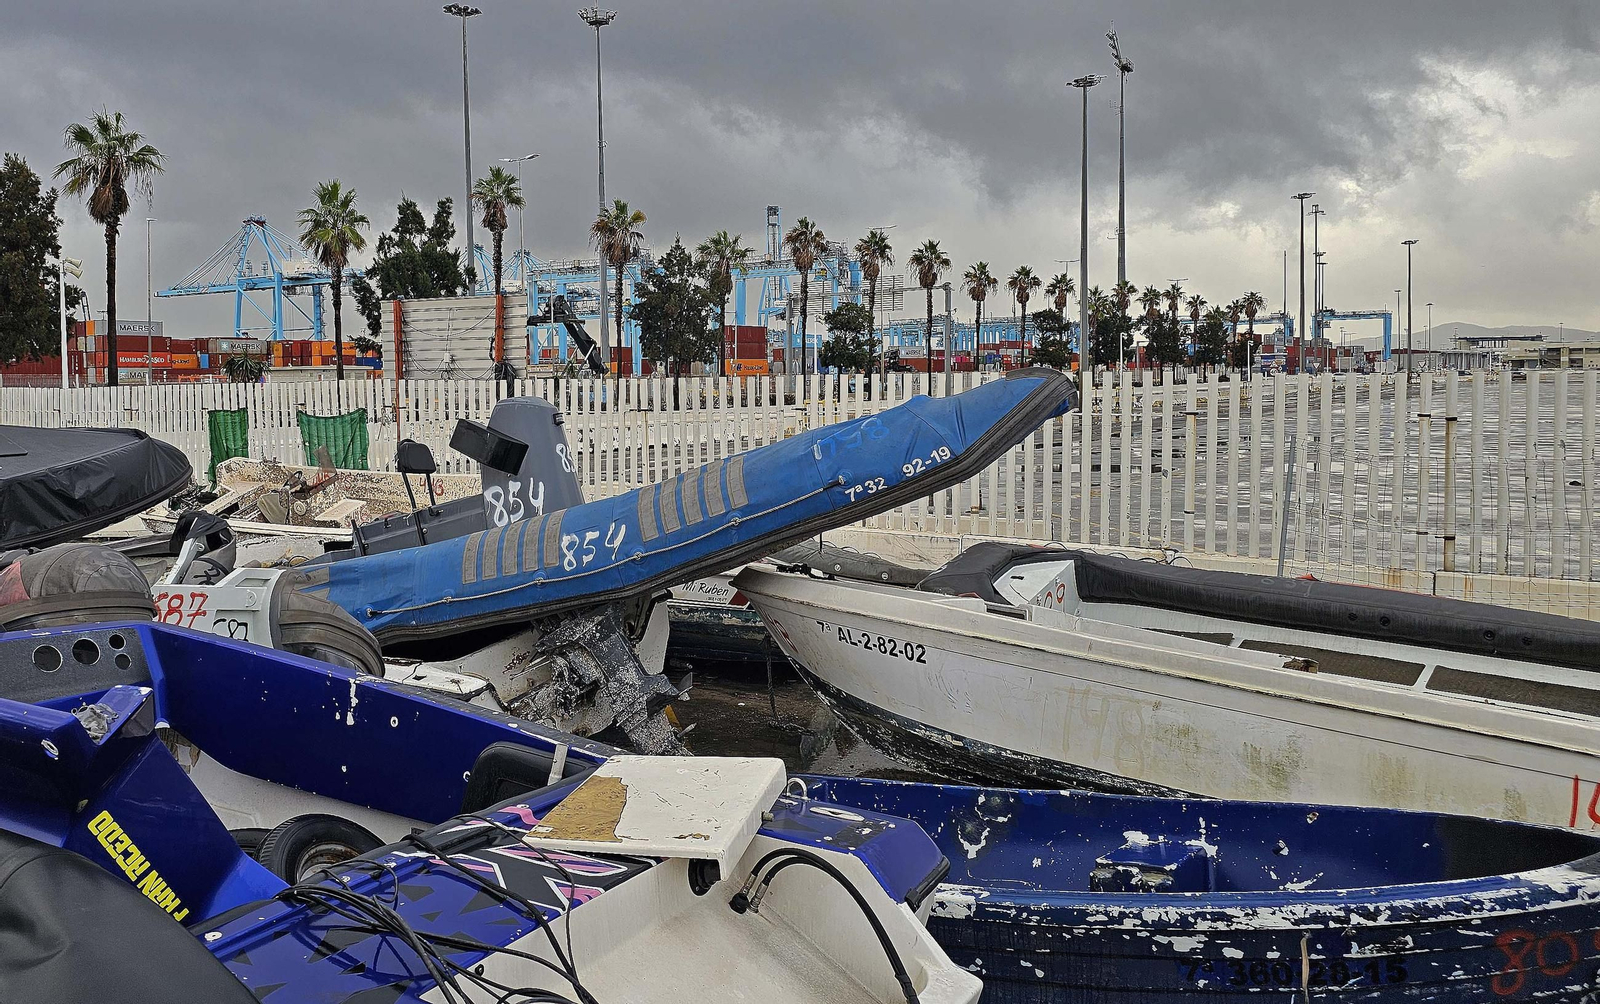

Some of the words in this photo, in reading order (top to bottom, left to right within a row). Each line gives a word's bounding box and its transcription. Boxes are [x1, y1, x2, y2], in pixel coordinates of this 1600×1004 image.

[119, 324, 154, 332] MAERSK
[902, 445, 951, 478] 92-19
[484, 477, 545, 527] 854
[864, 477, 888, 494] 32
[561, 521, 627, 572] 854
[837, 626, 927, 664] AL-2-82-02
